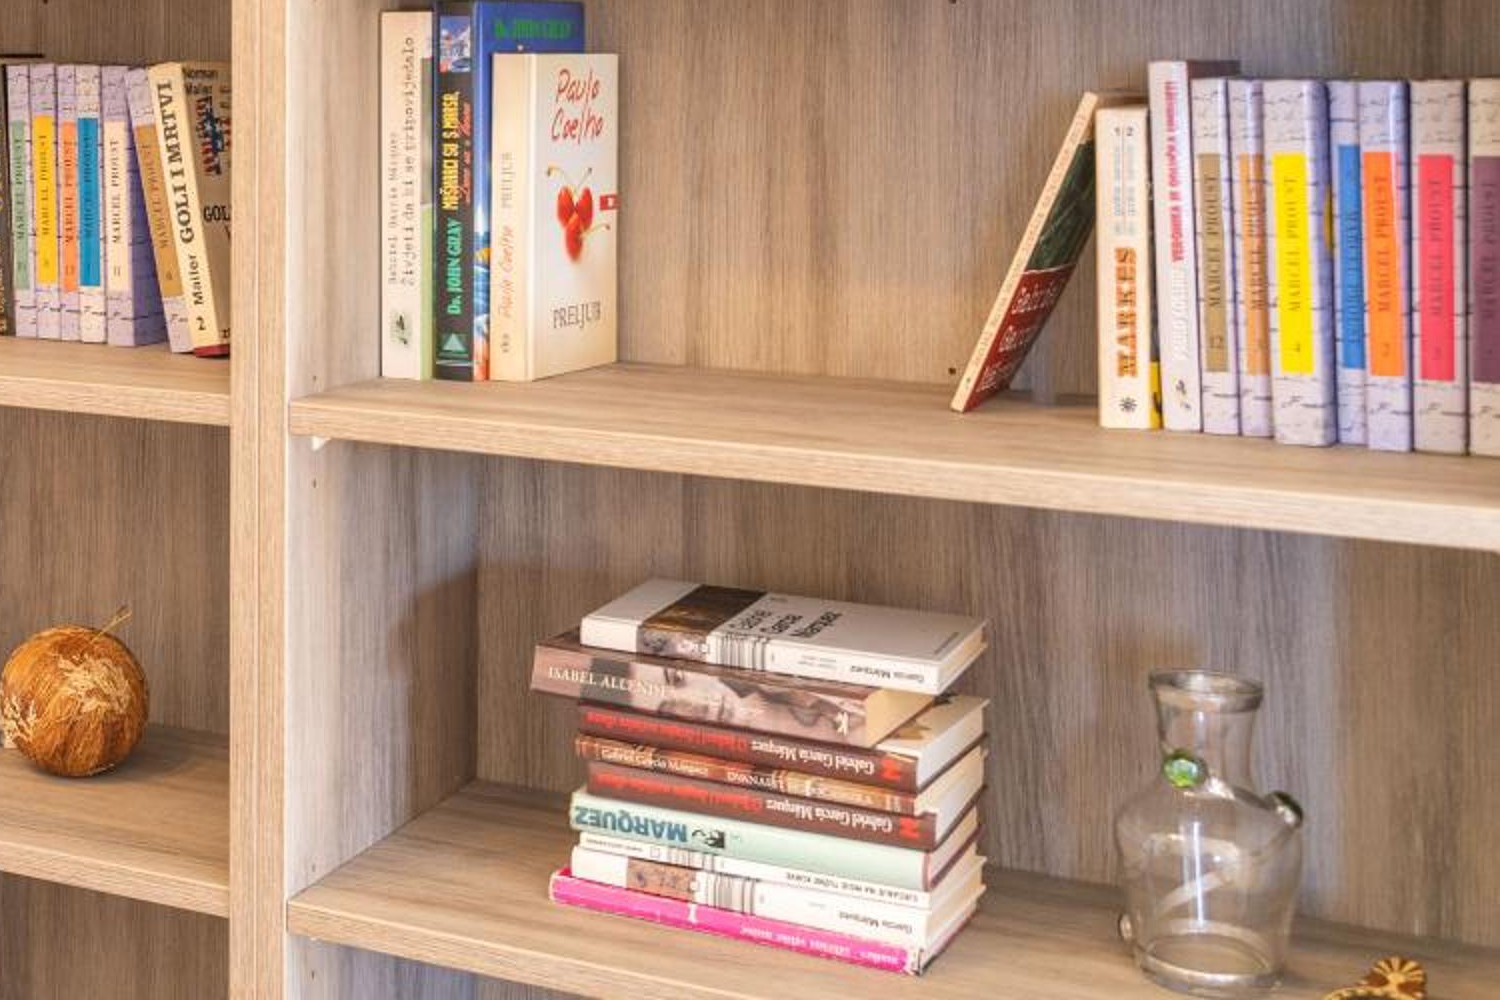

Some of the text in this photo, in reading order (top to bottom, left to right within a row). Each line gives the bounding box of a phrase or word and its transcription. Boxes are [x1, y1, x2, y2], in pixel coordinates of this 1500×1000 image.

[555, 67, 601, 104] Paulo
[157, 80, 183, 164] MRTVI
[550, 110, 606, 143] Coelho
[174, 178, 196, 244] GOLI
[445, 218, 461, 255] GRAY
[188, 254, 204, 306] Mailer
[446, 257, 463, 292] JOHN
[551, 300, 601, 330] PRELJUB
[548, 666, 596, 685] ISABEL
[835, 753, 875, 775] Gabriel
[574, 806, 688, 843] MARQUEZ
[766, 799, 813, 821] Márquez
[852, 812, 893, 832] Gabriel
